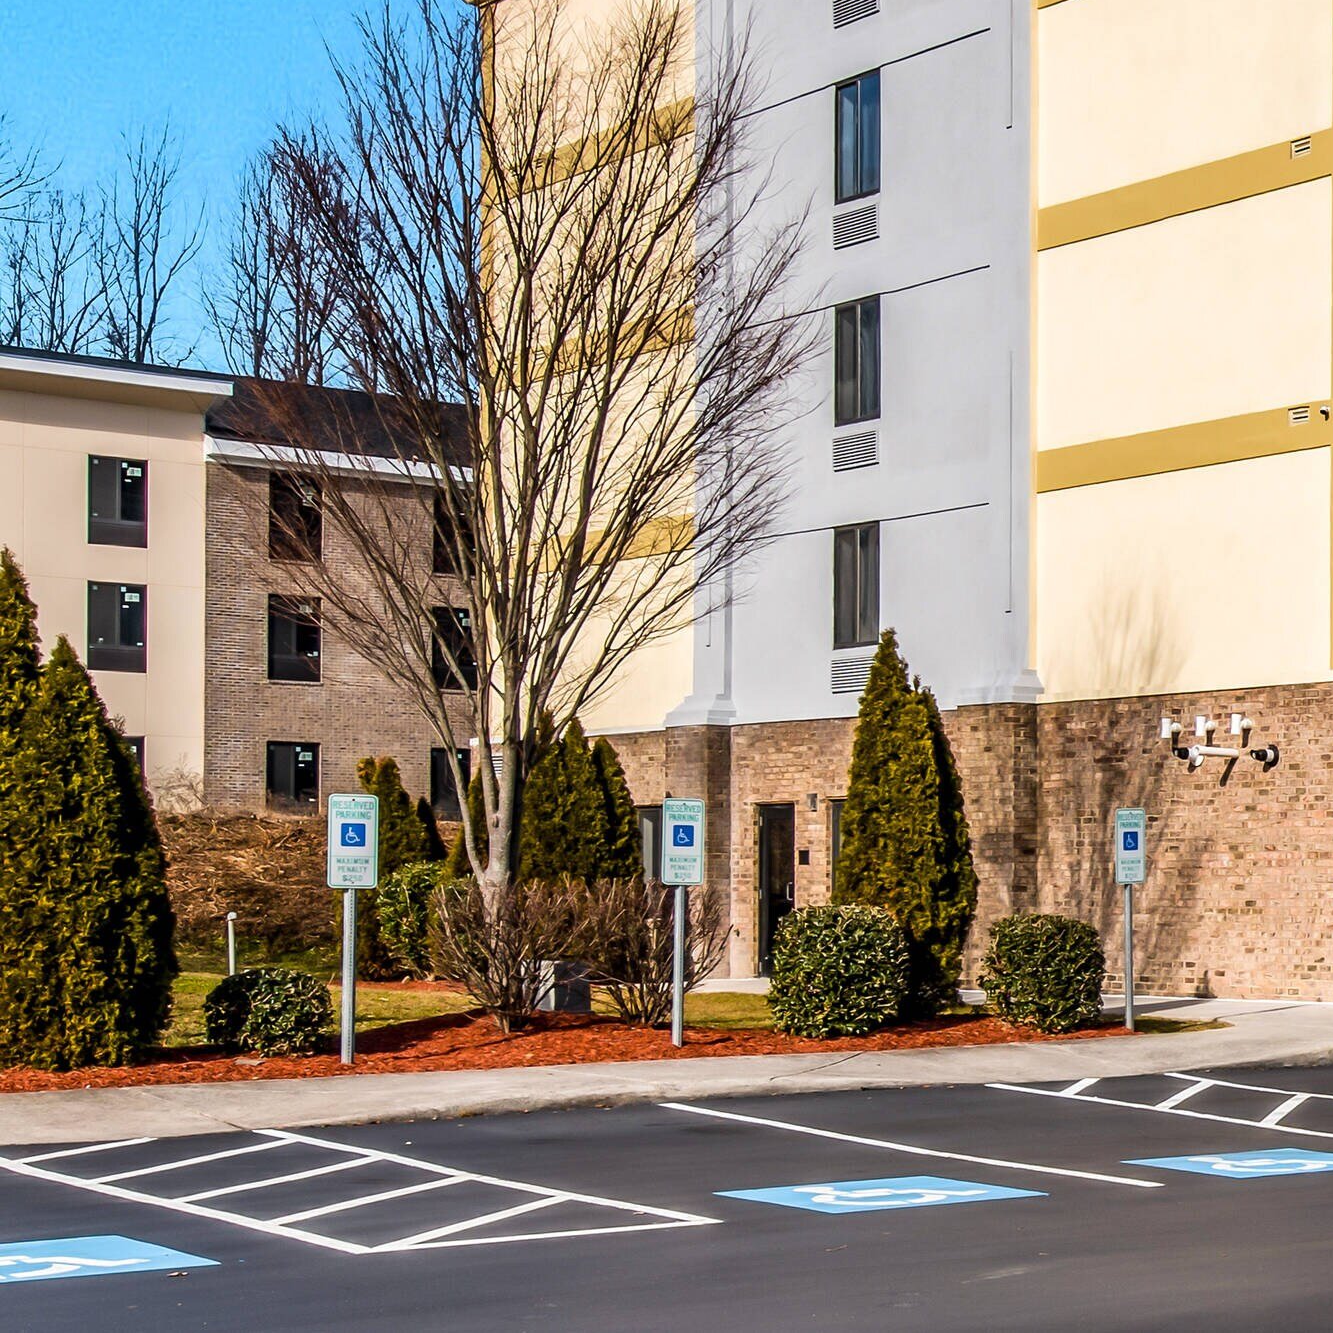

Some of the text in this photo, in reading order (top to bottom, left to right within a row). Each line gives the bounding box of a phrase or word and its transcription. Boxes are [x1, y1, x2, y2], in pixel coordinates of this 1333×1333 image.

[332, 801, 374, 811] RESERVED
[665, 804, 702, 813] RESERVED
[335, 810, 372, 820] PARKING
[669, 813, 700, 822] PARKING
[336, 857, 370, 865] MAXIMUM
